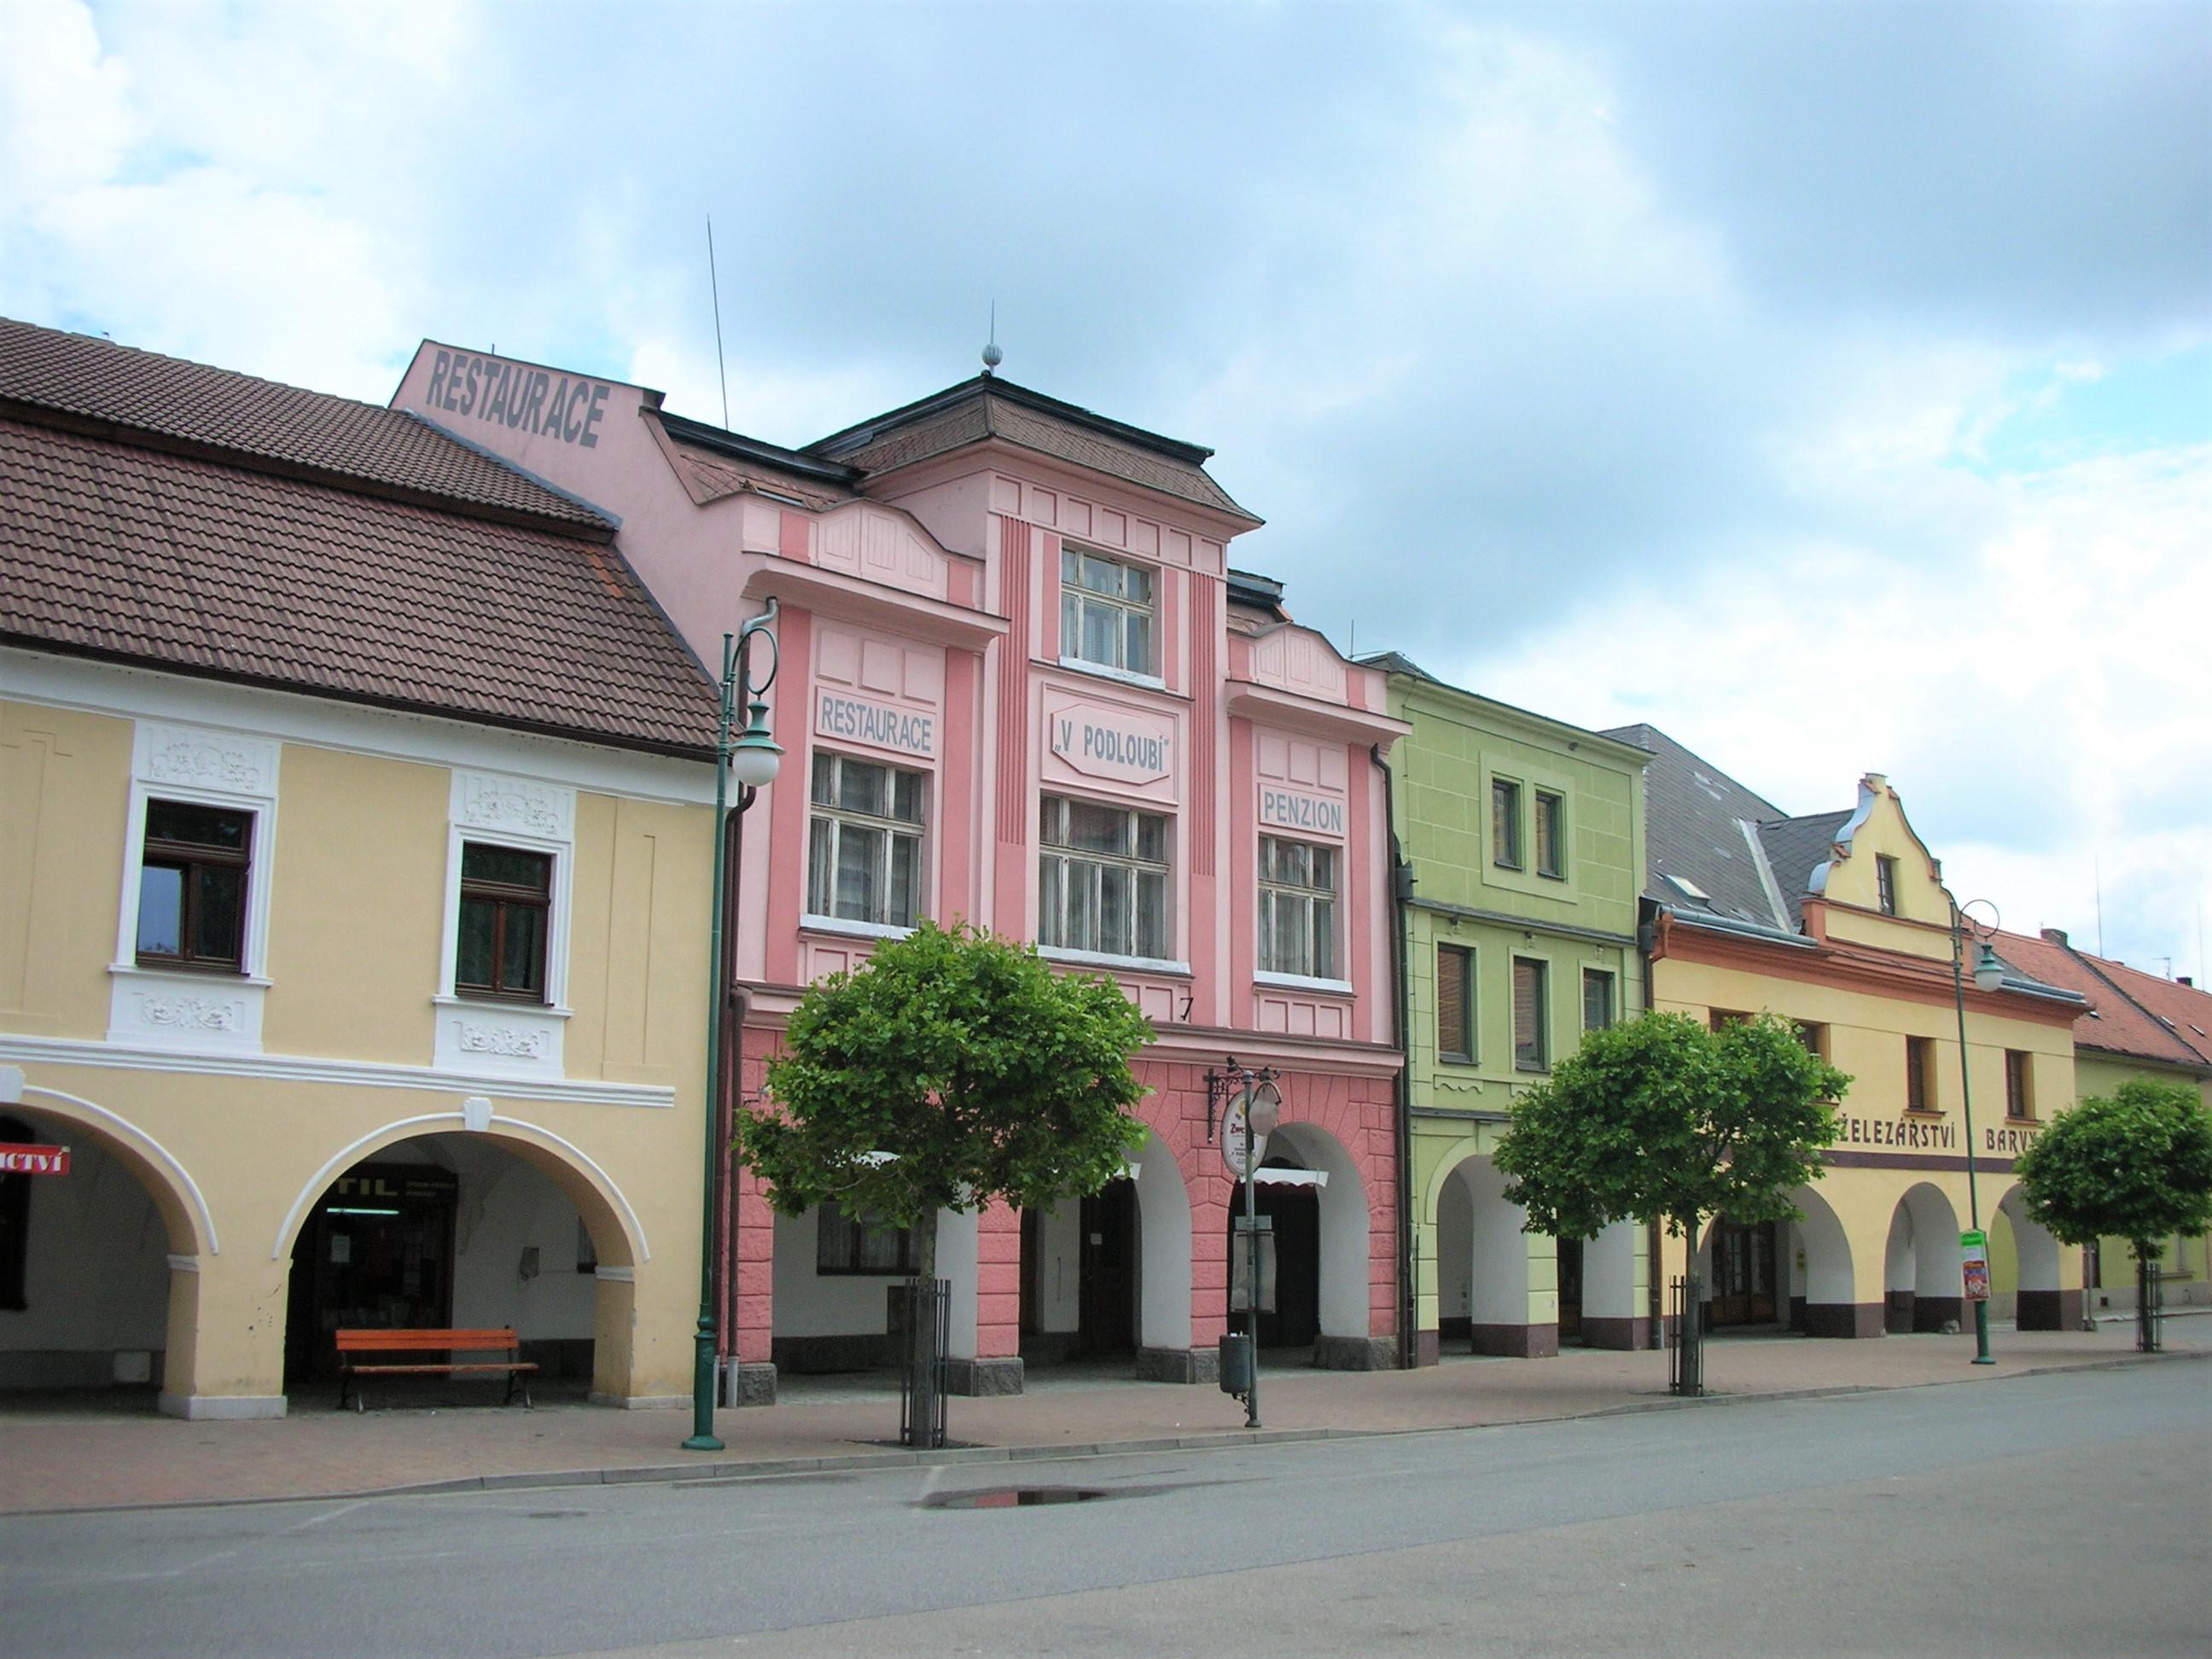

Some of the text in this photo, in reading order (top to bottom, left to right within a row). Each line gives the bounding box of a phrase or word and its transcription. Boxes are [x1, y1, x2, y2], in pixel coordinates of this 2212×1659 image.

[425, 350, 610, 449] RESTAURACE
[821, 696, 932, 752] RESTAURACE
[1264, 791, 1342, 832] PENZION
